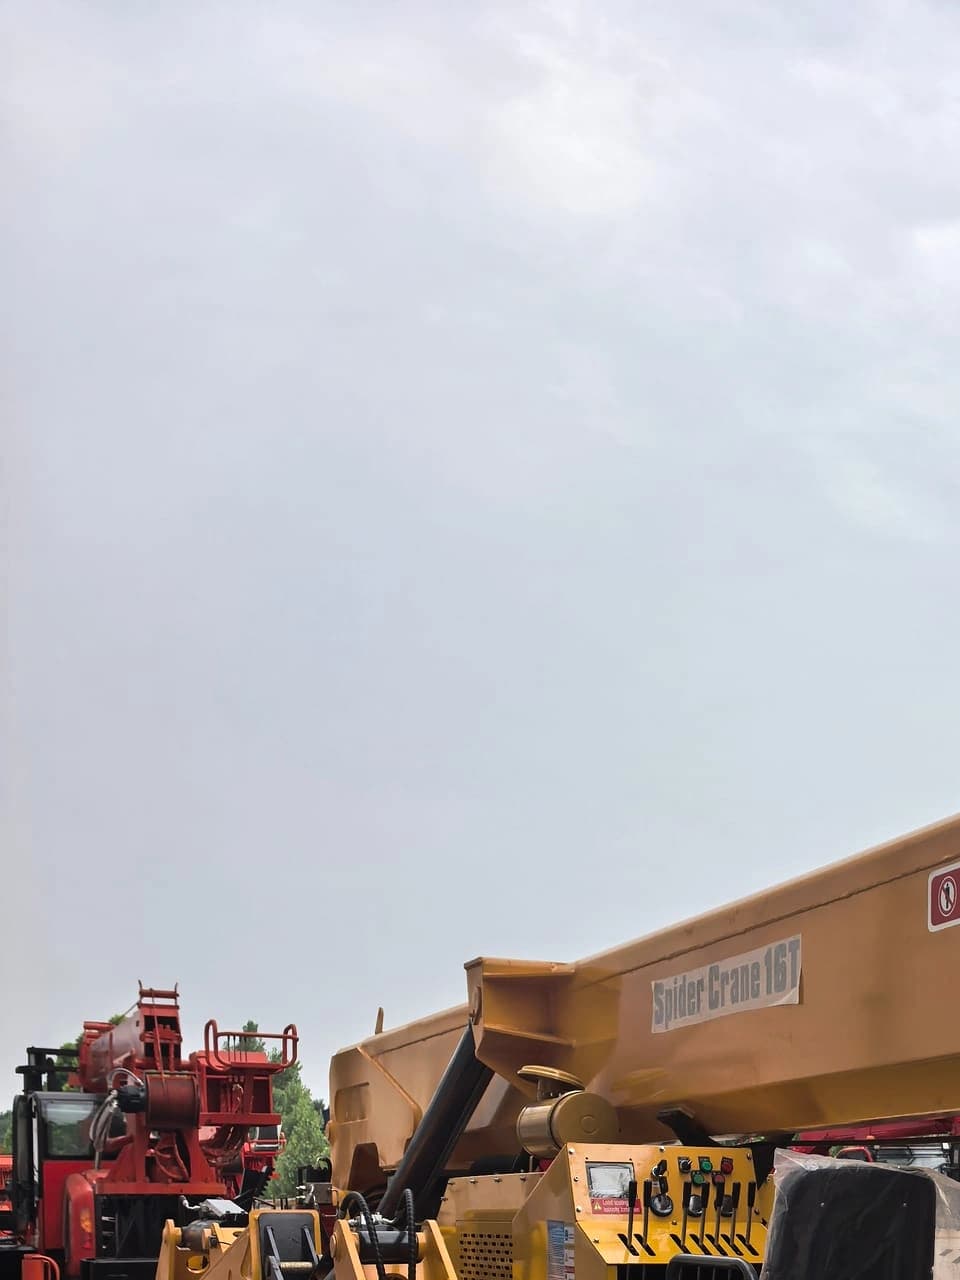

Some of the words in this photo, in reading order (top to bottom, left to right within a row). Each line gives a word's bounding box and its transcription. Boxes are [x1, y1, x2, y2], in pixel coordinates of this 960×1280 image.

[654, 975, 705, 1030] Spider
[708, 961, 761, 1010] Crane
[764, 939, 801, 995] 16T
